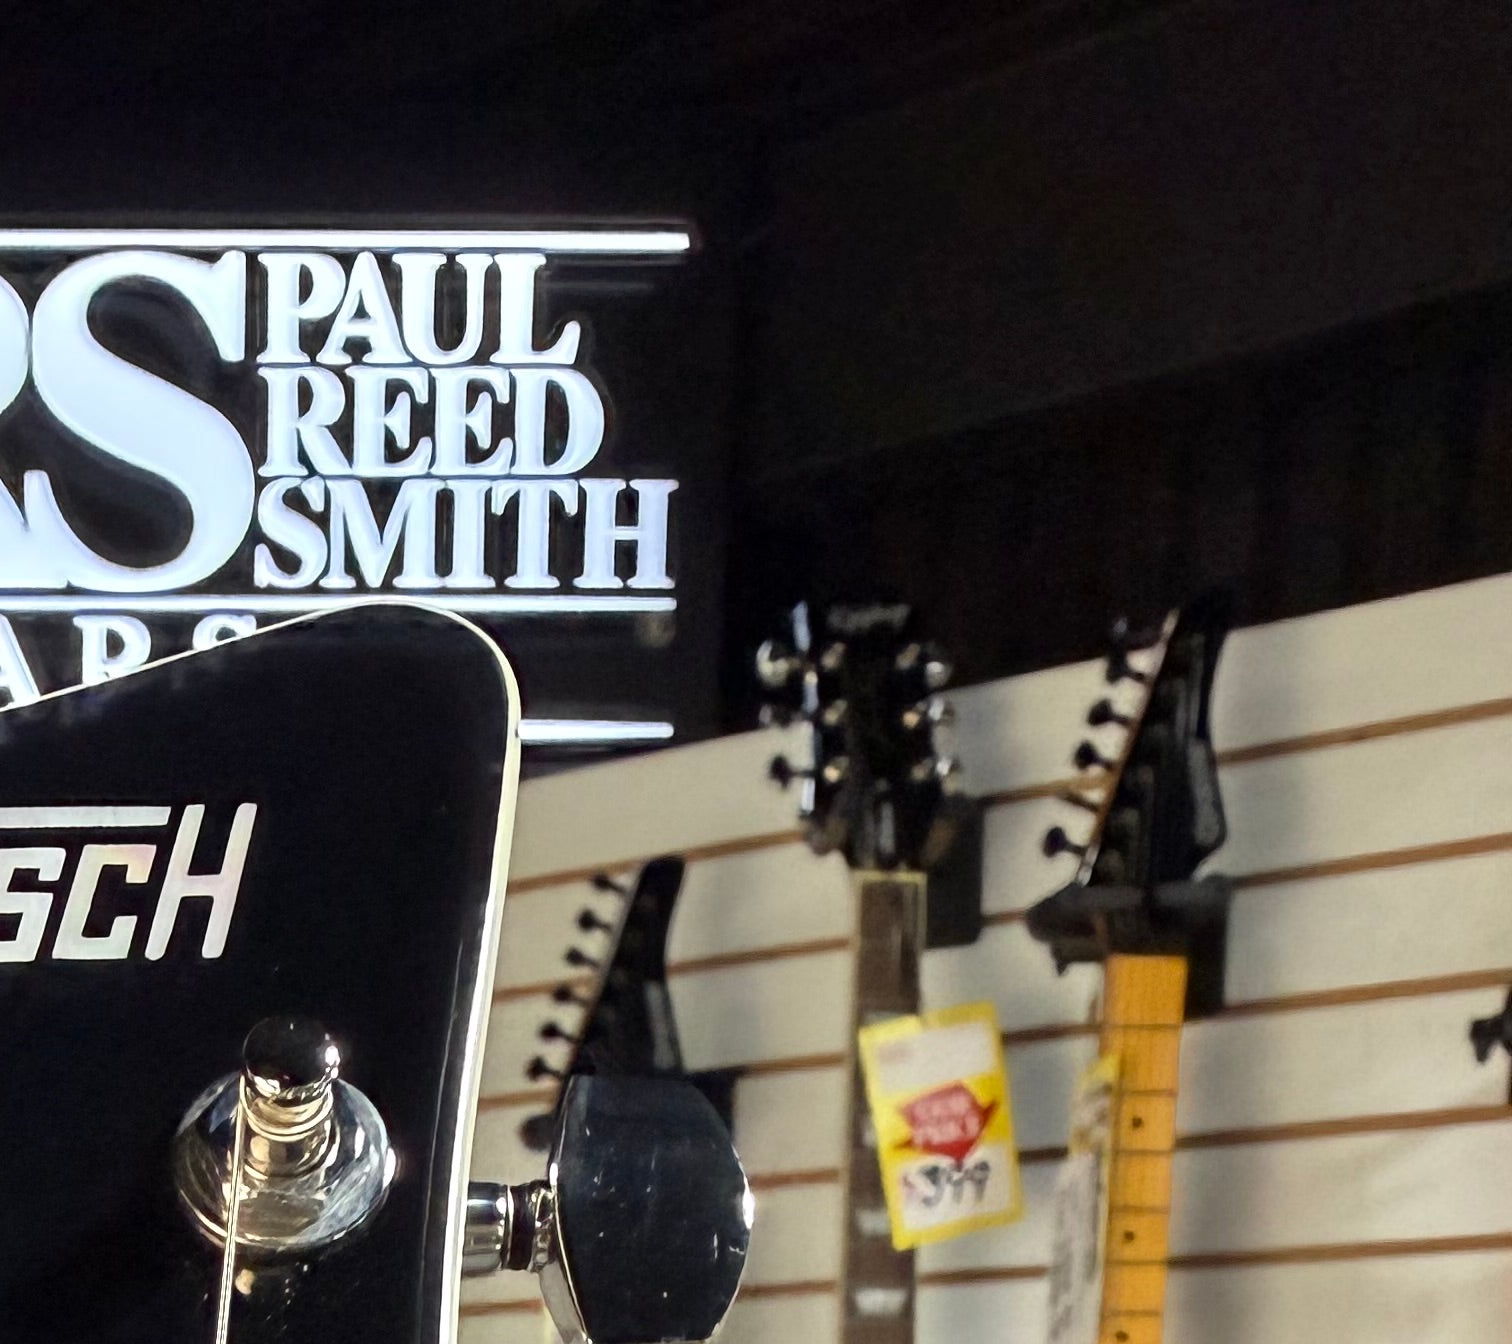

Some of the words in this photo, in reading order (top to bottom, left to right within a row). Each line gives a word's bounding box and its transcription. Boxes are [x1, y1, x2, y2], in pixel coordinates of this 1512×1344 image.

[257, 251, 581, 365] PAUL
[257, 366, 605, 476] REED
[254, 476, 679, 589] SMITH
